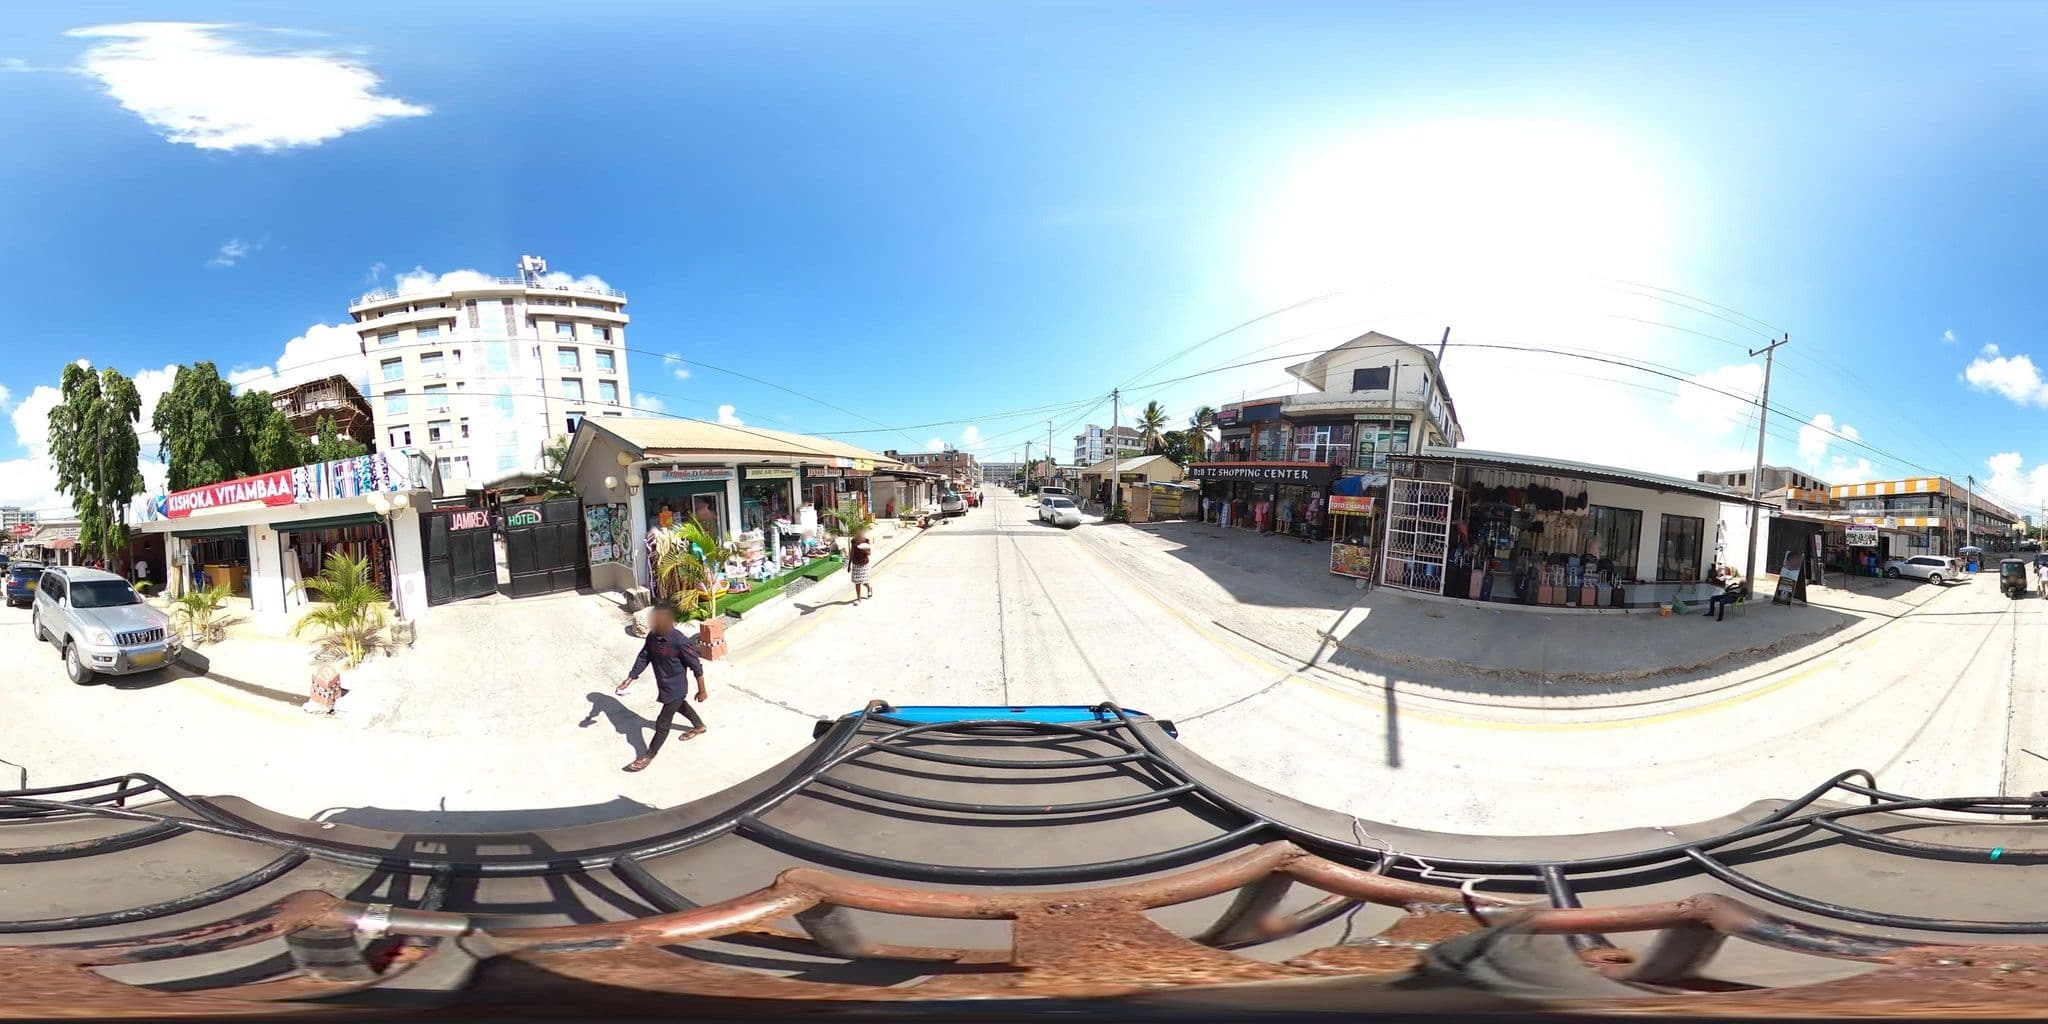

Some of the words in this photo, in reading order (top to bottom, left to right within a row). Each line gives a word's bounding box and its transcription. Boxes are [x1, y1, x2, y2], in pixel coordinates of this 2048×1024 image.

[1207, 468, 1217, 477] TZ
[1218, 468, 1260, 478] SHOPPING
[1263, 469, 1309, 479] CENTER
[169, 489, 214, 512] KISHOKA
[215, 475, 291, 504] VITAMBAA
[508, 513, 537, 527] HOTEL
